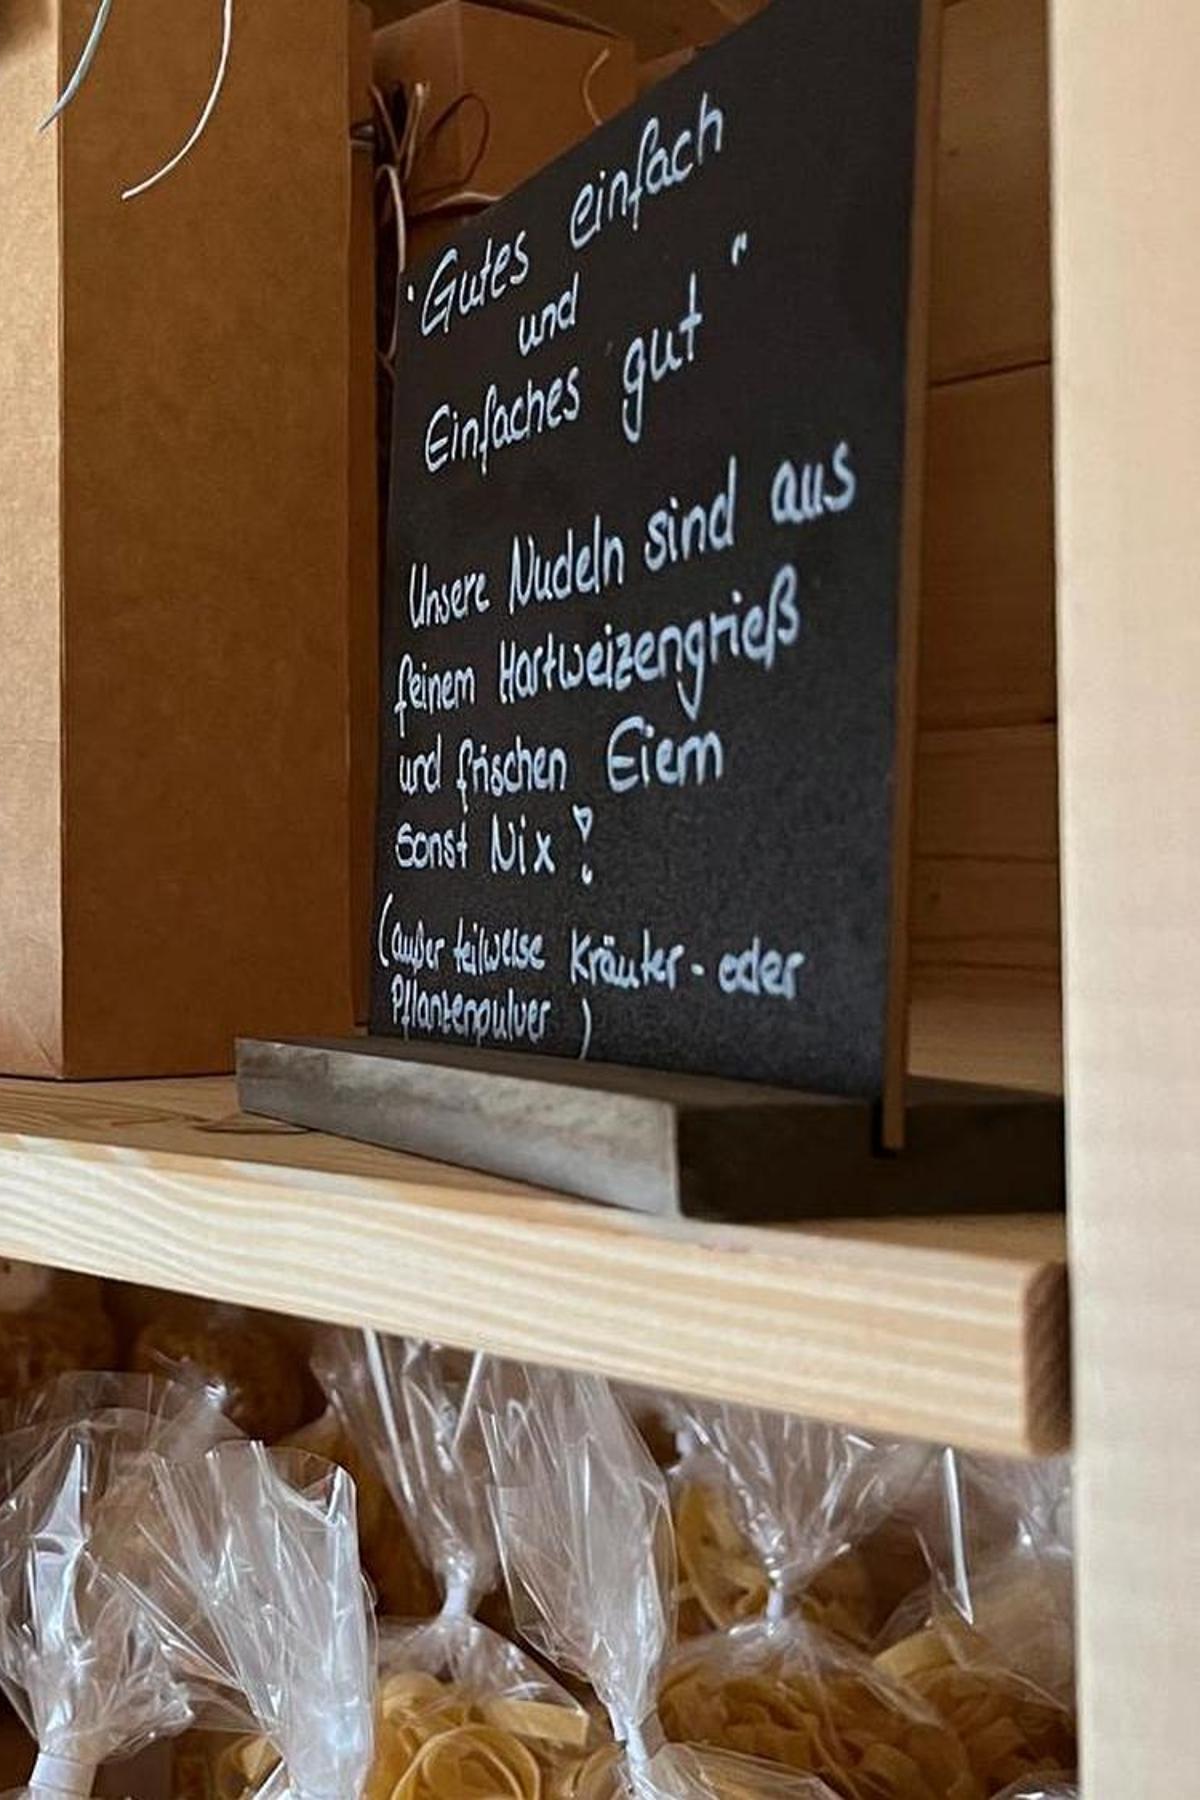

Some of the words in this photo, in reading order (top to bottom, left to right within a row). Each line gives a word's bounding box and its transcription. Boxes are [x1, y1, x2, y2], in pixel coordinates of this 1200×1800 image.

[570, 91, 723, 250] einfach
[519, 273, 580, 355] und
[425, 366, 581, 475] Einfaches
[408, 563, 491, 629] Unsere
[509, 515, 624, 614] Nudeln
[645, 455, 738, 571] sind
[770, 441, 857, 524] aus
[394, 653, 476, 738] feinem
[500, 564, 801, 721] Hartweizengrieß
[400, 734, 442, 796] und
[457, 735, 568, 813] frischen
[607, 715, 724, 793] Eiern
[454, 917, 546, 976] teilweise
[717, 937, 805, 999] oder
